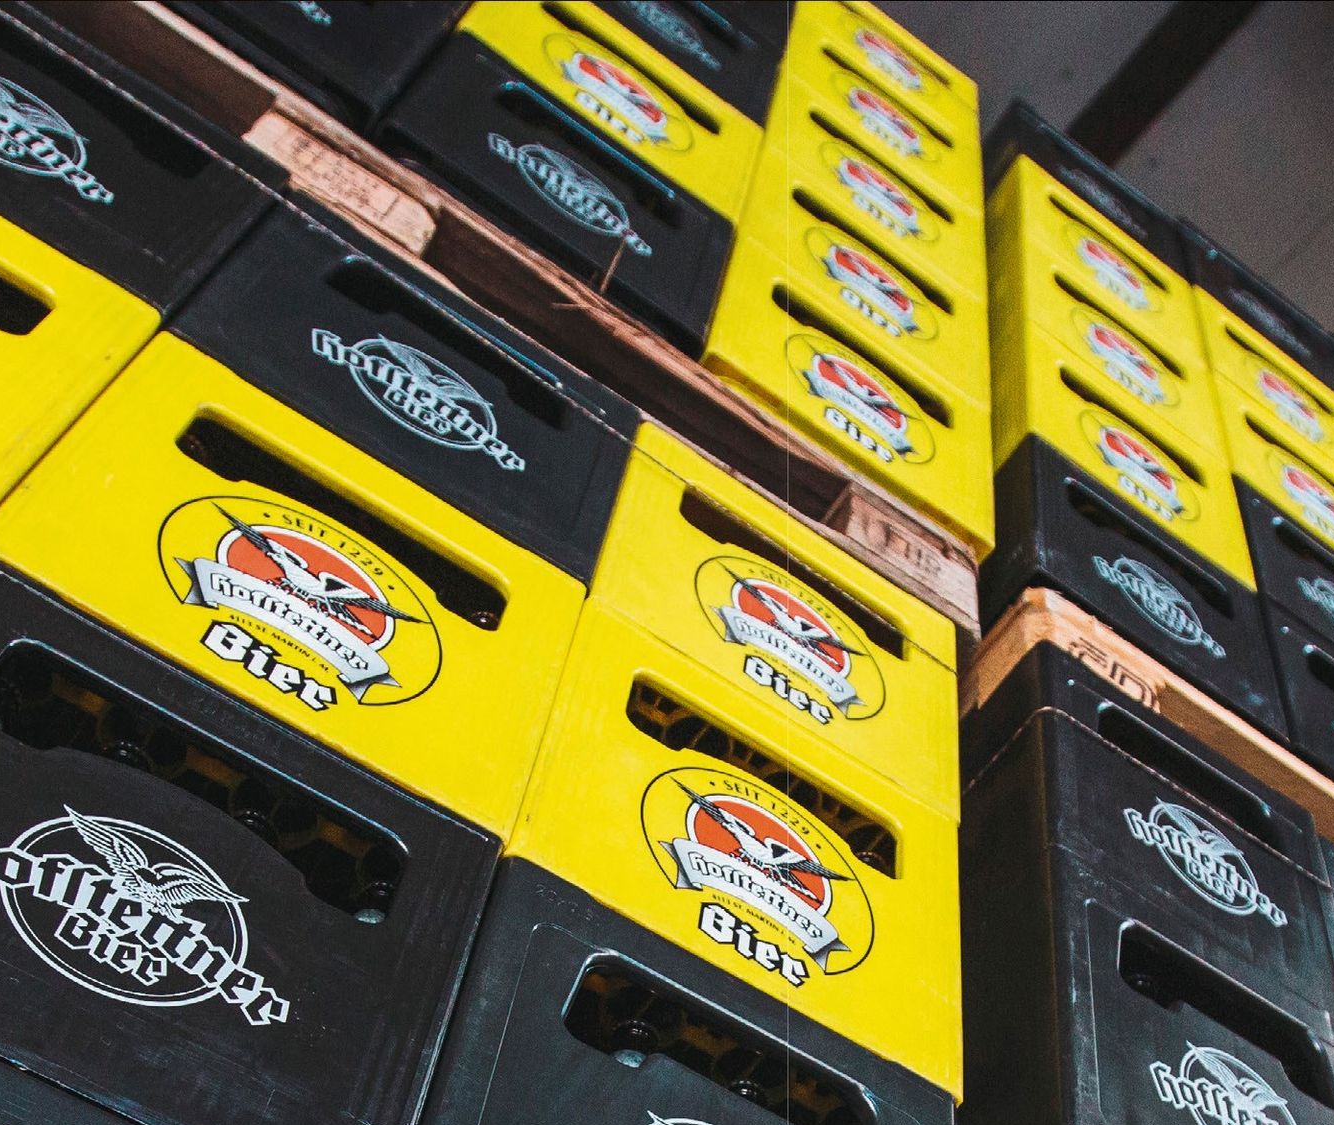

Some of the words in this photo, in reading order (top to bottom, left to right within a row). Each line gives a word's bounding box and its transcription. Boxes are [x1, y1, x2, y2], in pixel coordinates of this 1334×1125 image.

[281, 513, 328, 538] SEIT
[338, 541, 384, 578] 1229
[200, 619, 337, 712] Bier
[270, 631, 311, 658] MARTIN
[743, 654, 833, 725] Bier
[722, 780, 760, 801] SEIT
[770, 803, 811, 836] 1229
[55, 909, 168, 987] Bier
[698, 902, 810, 987] Bier
